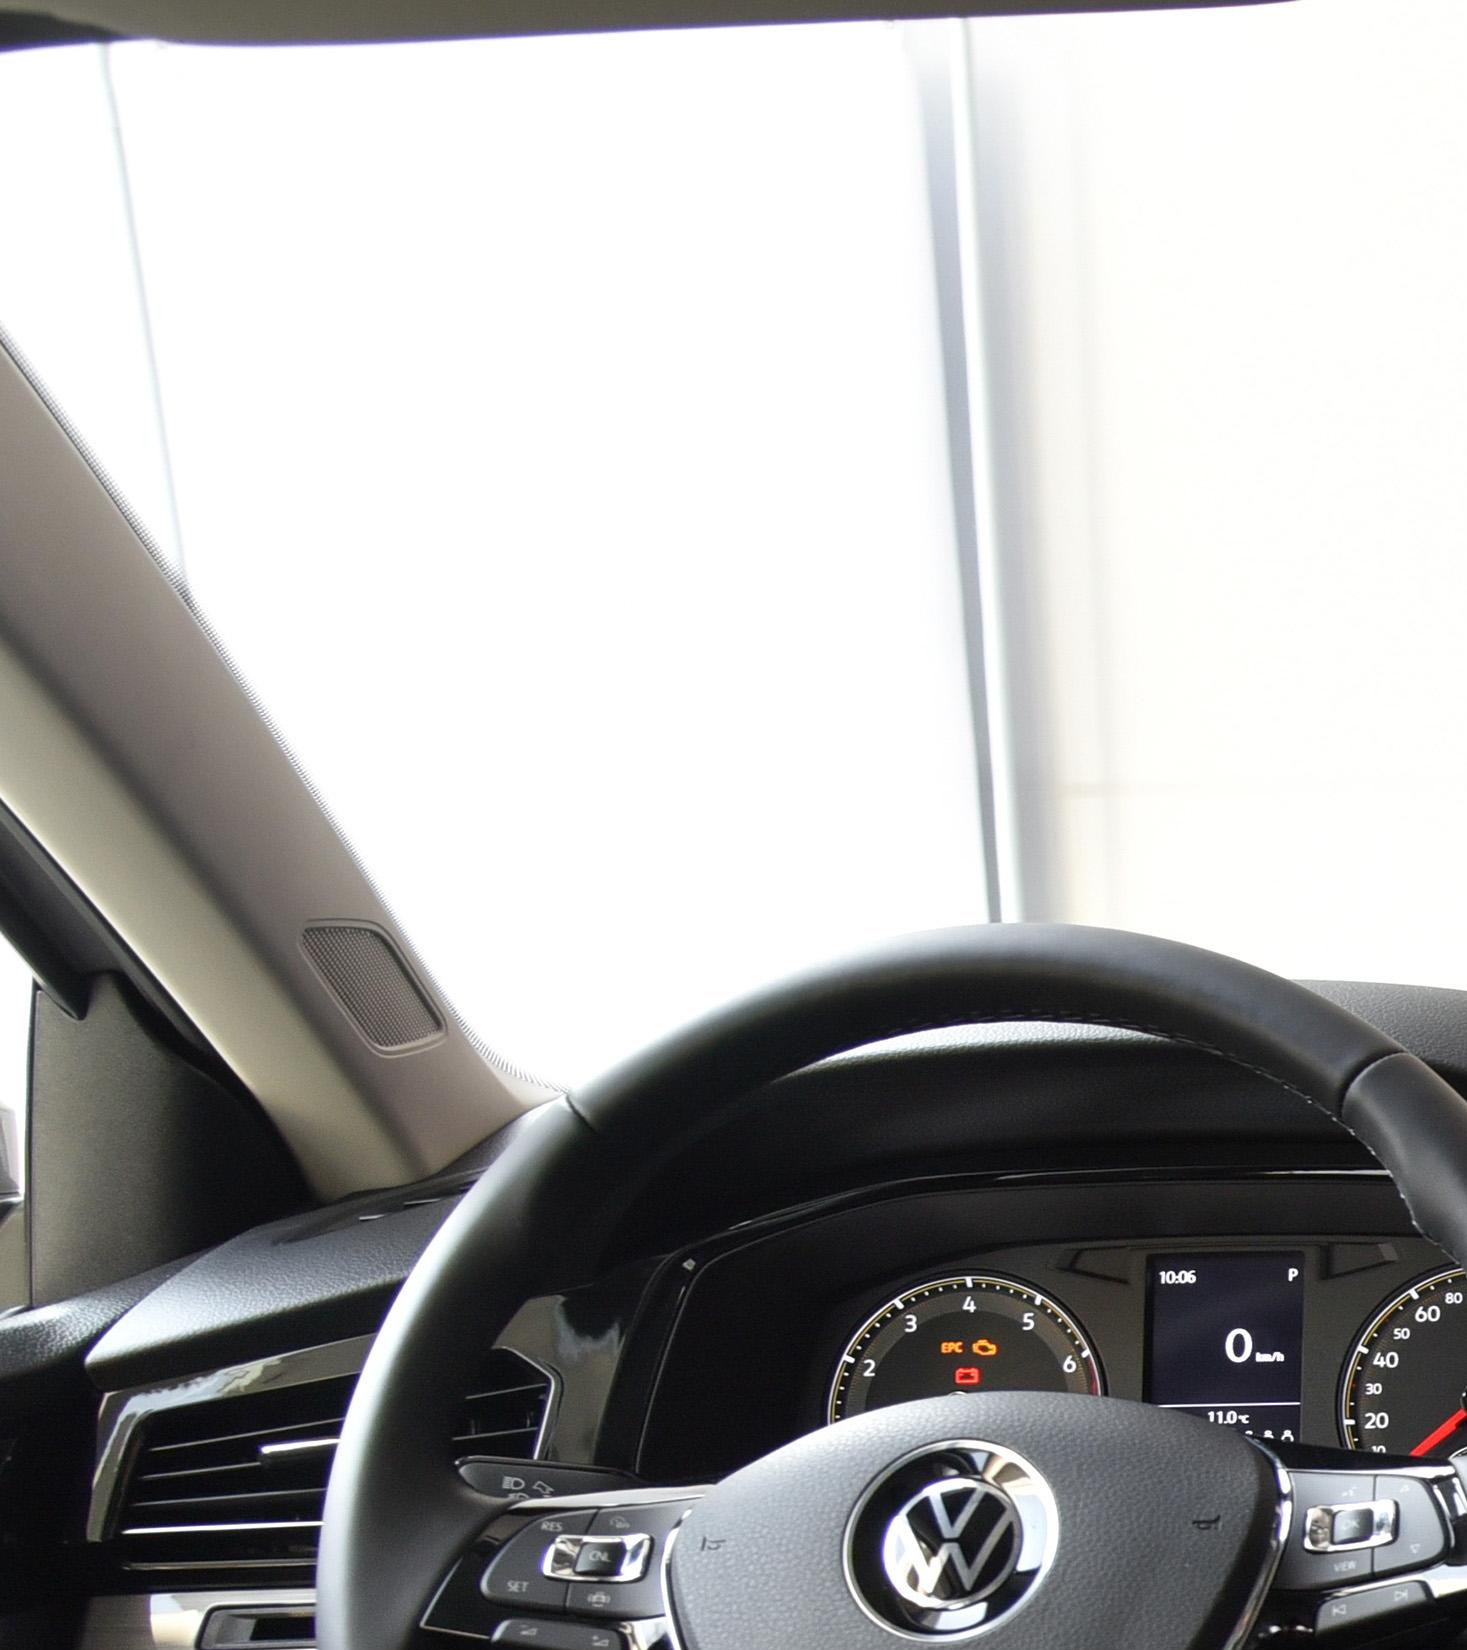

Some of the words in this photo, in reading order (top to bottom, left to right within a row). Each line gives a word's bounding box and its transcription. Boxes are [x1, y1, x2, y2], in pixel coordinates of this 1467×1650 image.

[1159, 1270, 1197, 1285] 10:06
[1288, 1268, 1299, 1282] P
[962, 1296, 976, 1313] 4
[1445, 1292, 1463, 1304] 80
[1022, 1312, 1035, 1330] 5
[1415, 1306, 1441, 1322] 60
[904, 1314, 917, 1333] 3
[1393, 1328, 1410, 1340] 50
[941, 1341, 963, 1354] EPC
[1225, 1328, 1253, 1363] 0
[863, 1359, 876, 1377] 2
[1063, 1355, 1076, 1373] 6
[1373, 1352, 1399, 1369] 40
[1365, 1383, 1383, 1395] 30
[1364, 1412, 1389, 1430] 20
[540, 1520, 563, 1532] RES
[588, 1550, 612, 1562] CNL
[1333, 1560, 1357, 1572] VIEW
[507, 1580, 529, 1593] SET
